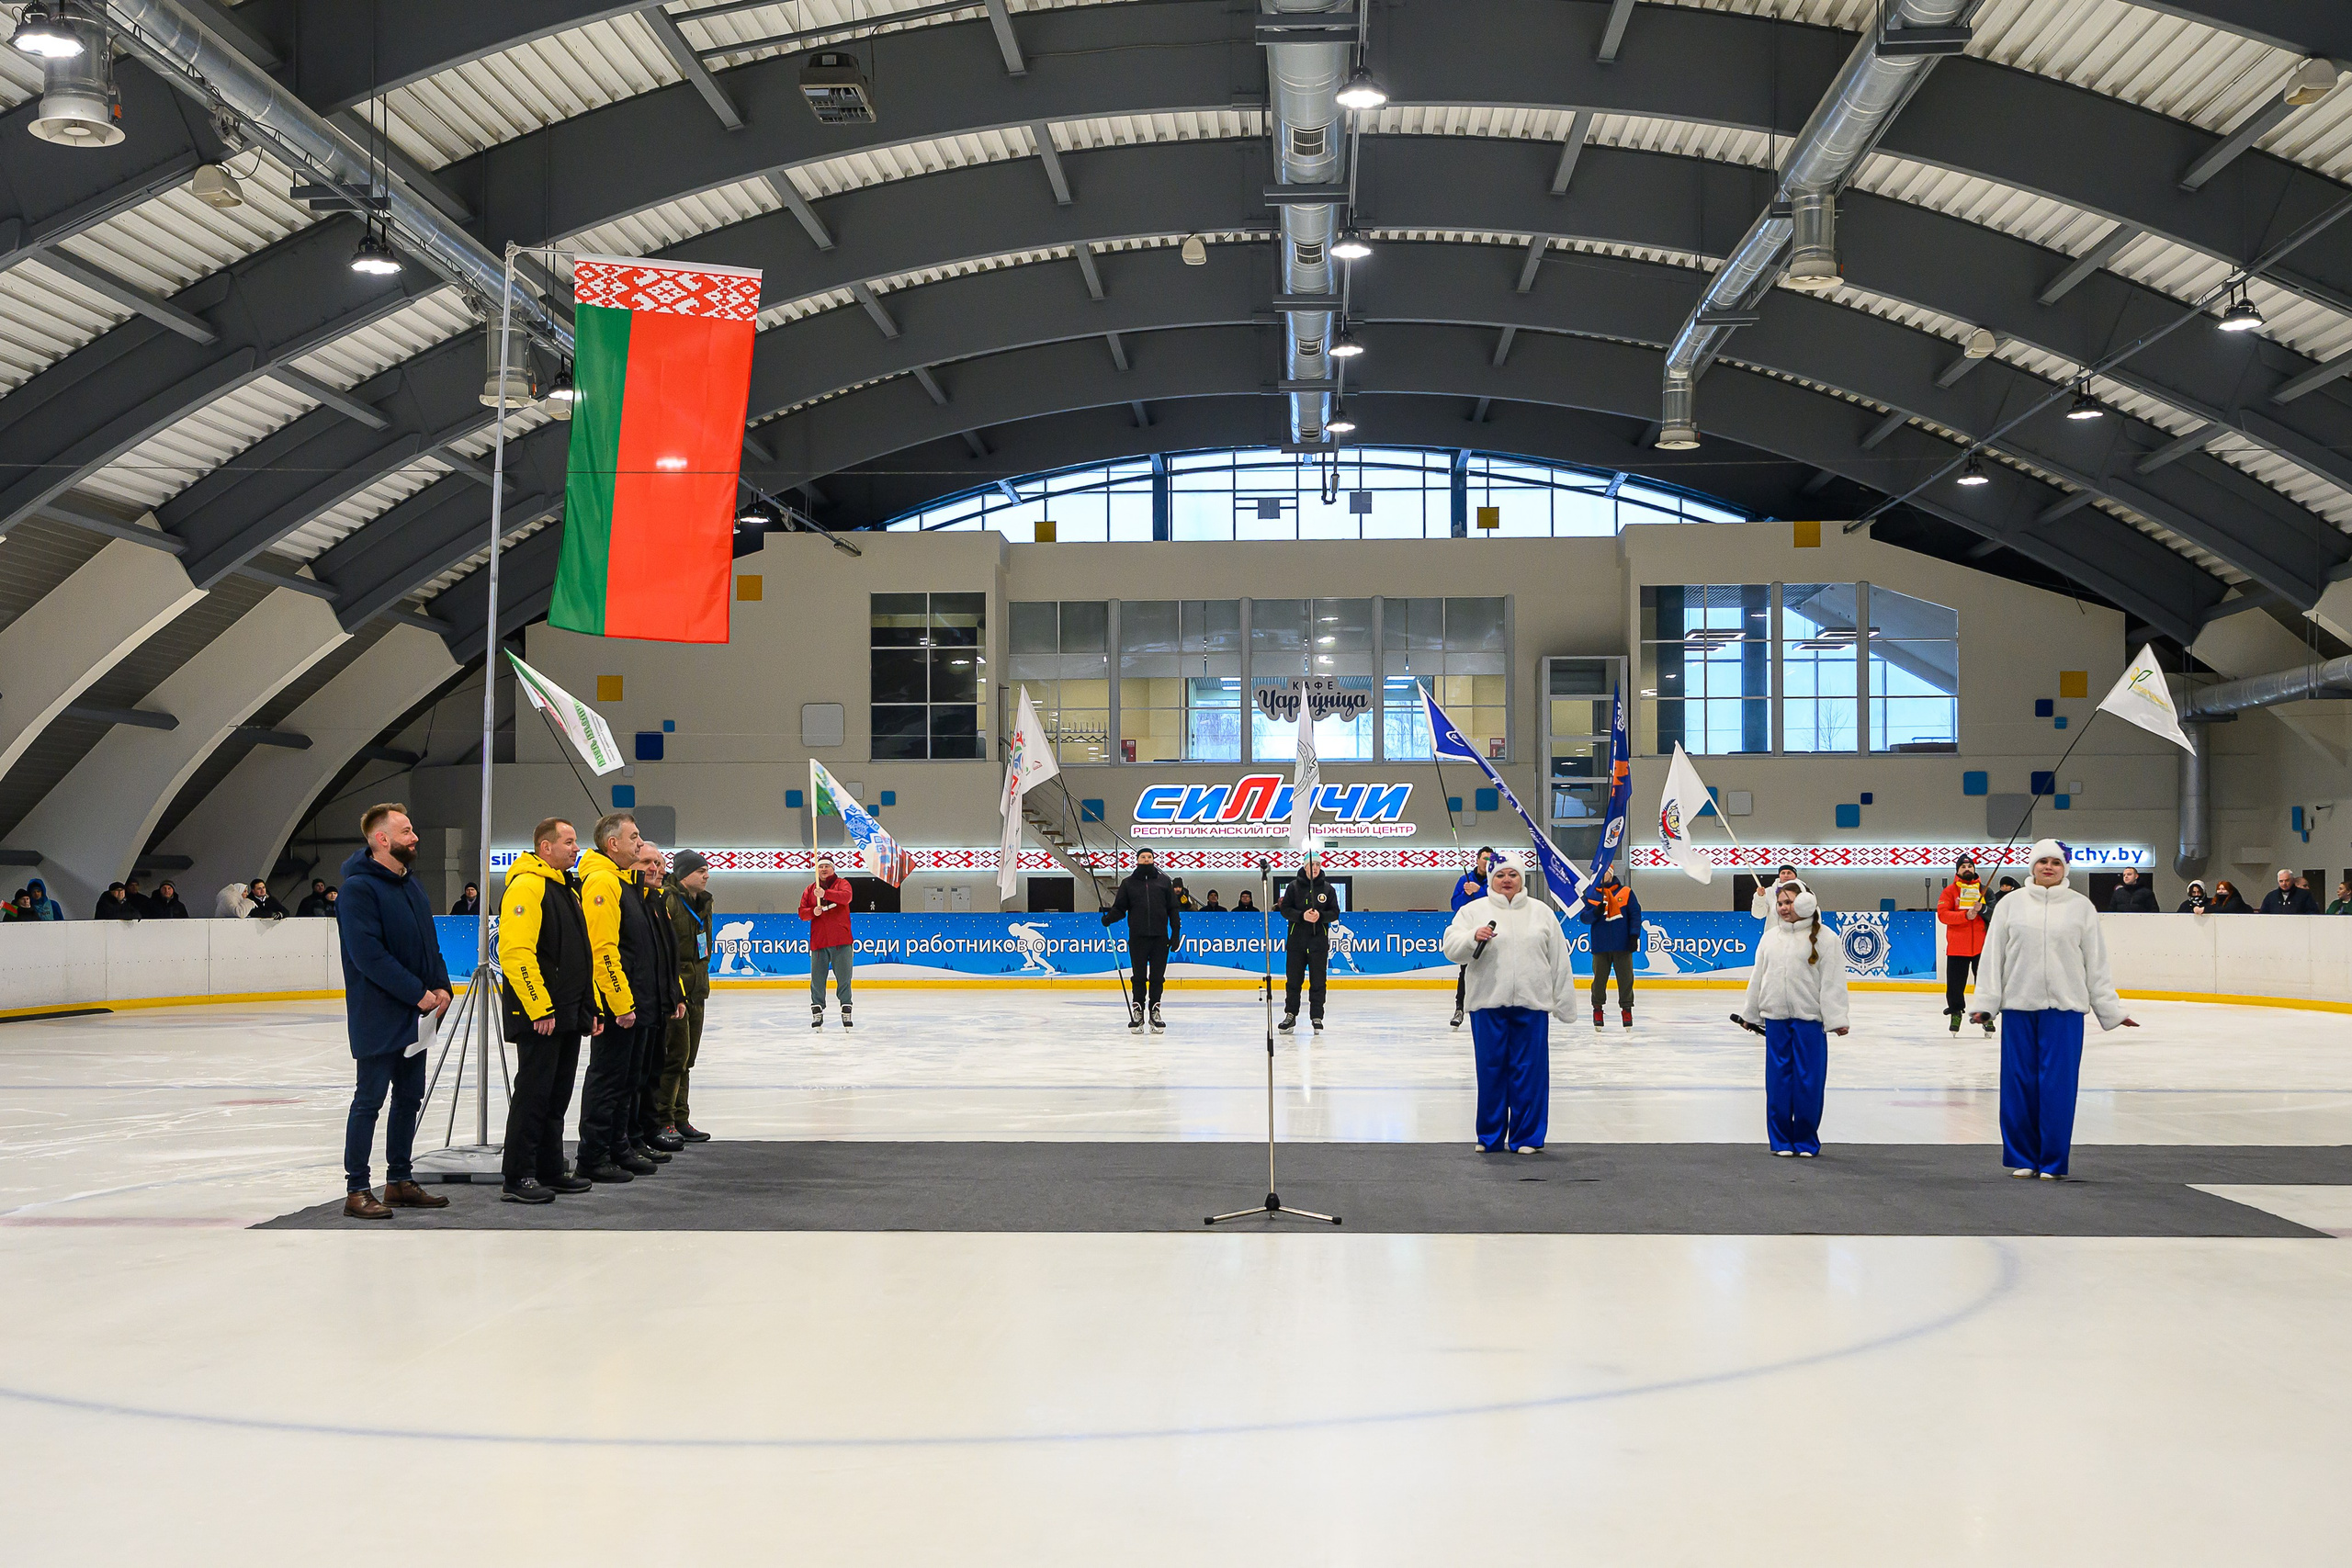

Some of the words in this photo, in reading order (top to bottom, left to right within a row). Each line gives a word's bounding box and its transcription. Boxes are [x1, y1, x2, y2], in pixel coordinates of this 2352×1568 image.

[1293, 681, 1333, 690] КАФЕ
[1133, 825, 1263, 835] РЕСПУБЛИКАНСКИЙ
[1266, 825, 1369, 835] ГОРЛЫЖНЫЙ
[1373, 826, 1414, 836] ЦЕНТР
[853, 938, 899, 957] реди
[905, 933, 1028, 957] работников
[1033, 938, 1128, 957] организа
[1175, 934, 1285, 957] Управлени
[1329, 938, 1380, 953] лами
[1647, 933, 1747, 957] Беларусь
[520, 965, 538, 1001] BELARUS
[603, 954, 622, 993] BELARUS
